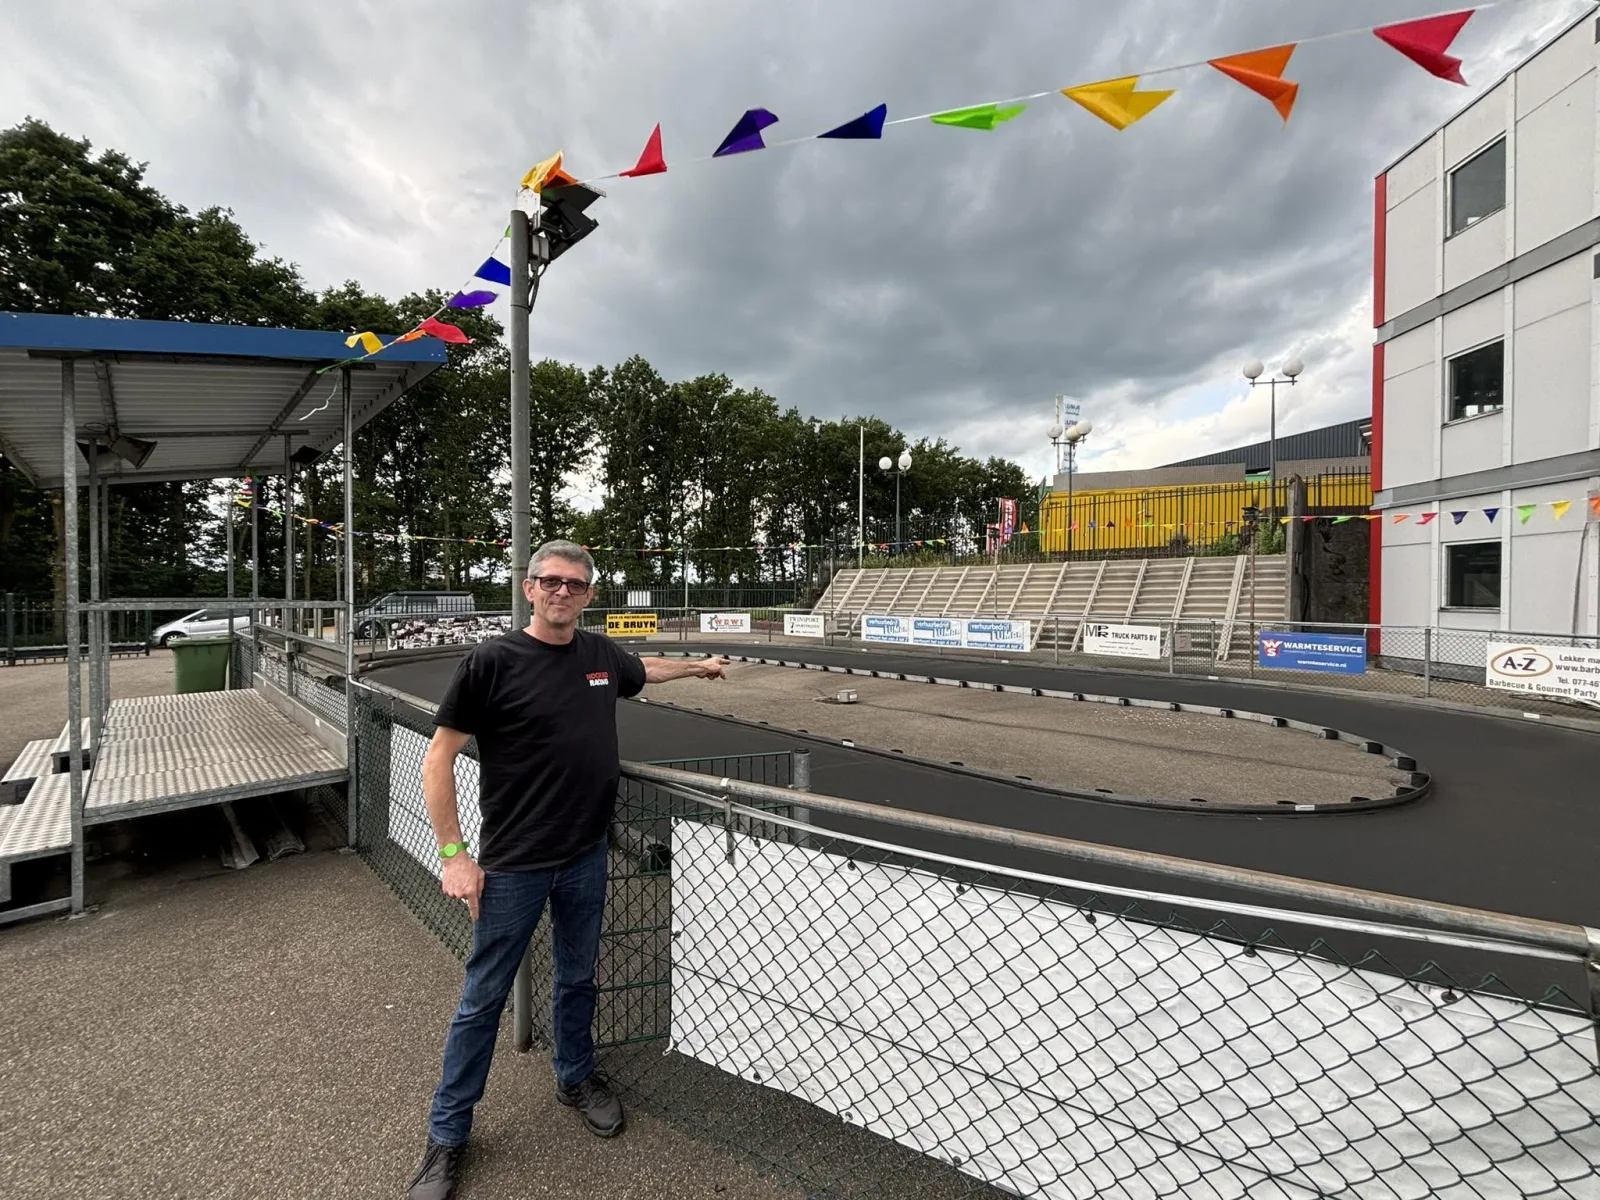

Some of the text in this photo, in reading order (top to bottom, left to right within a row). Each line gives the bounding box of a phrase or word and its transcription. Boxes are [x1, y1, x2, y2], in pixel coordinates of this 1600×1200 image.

[608, 620, 656, 629] DE BRUYN
[1130, 633, 1148, 641] PARTS
[1283, 641, 1364, 654] WARMTESERVICE
[1559, 654, 1586, 663] Lekker
[1297, 659, 1347, 668] warmteservice.nl
[1502, 656, 1537, 672] A-Z
[589, 678, 609, 687] RACING
[1489, 678, 1526, 689] Barbecue
[1536, 684, 1572, 695] Gourmet
[1573, 687, 1598, 699] Party
